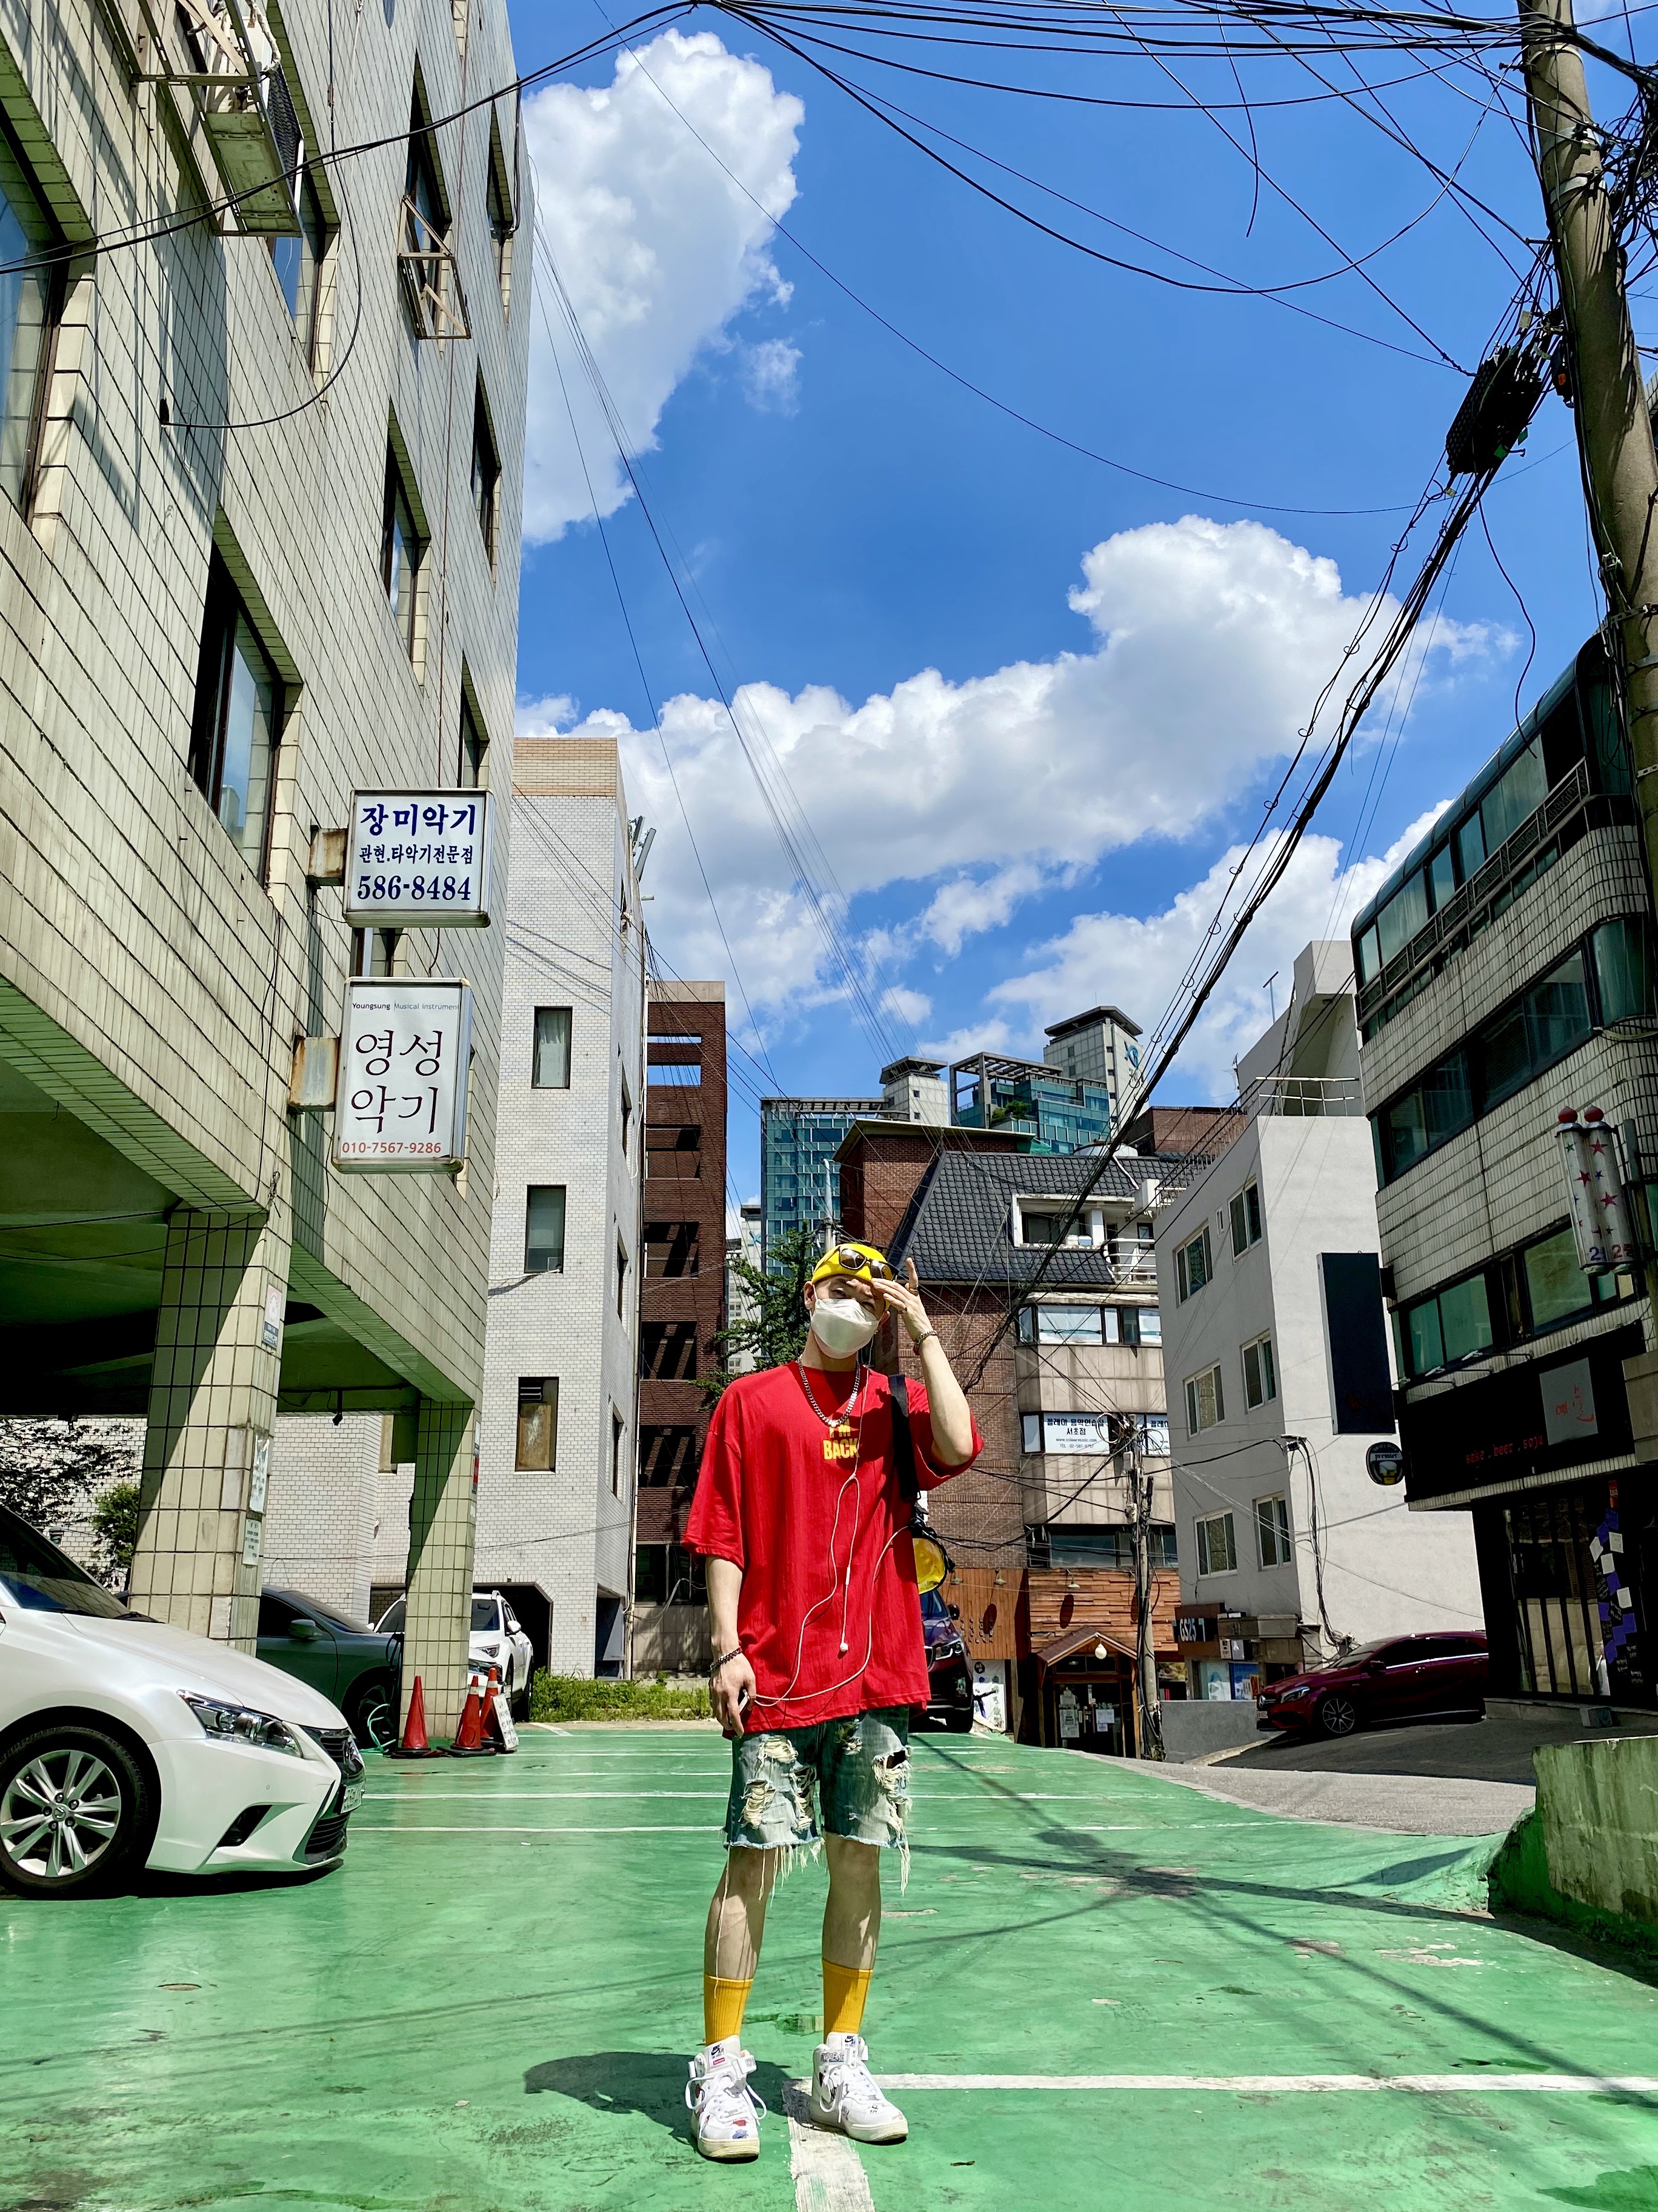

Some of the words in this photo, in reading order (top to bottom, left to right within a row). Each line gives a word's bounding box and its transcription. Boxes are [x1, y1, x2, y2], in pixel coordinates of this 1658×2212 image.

[360, 804, 476, 836] 장미악기
[359, 844, 473, 865] 관현.타악기전문점
[357, 875, 471, 901] 586-8484
[355, 1030, 443, 1076] 영성
[351, 1085, 439, 1134] 악기
[342, 1142, 442, 1154] 010-7567-9286
[1066, 1427, 1087, 1436] 서초점
[823, 1438, 860, 1460] BACK
[1493, 1444, 1513, 1457] beer
[1523, 1434, 1543, 1449] soju
[1179, 1617, 1197, 1642] GS25
